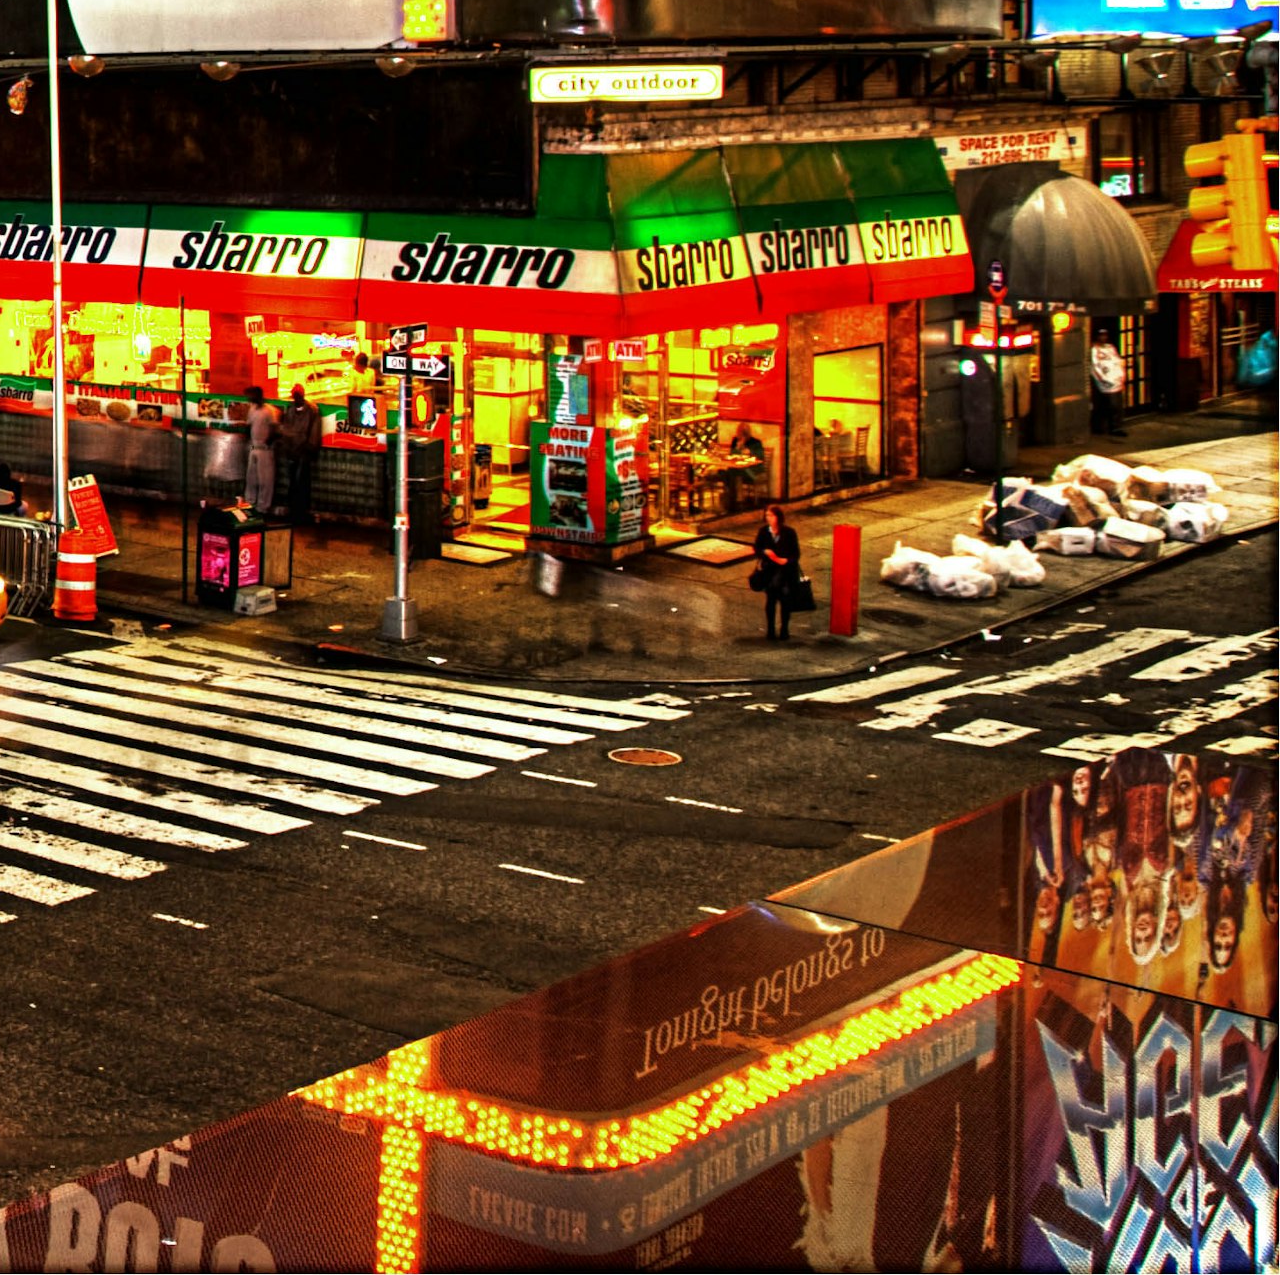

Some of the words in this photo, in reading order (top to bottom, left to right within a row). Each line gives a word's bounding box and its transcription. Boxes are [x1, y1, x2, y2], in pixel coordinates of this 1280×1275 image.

[558, 75, 598, 97] city
[610, 73, 700, 92] outdoor
[959, 136, 998, 151] SPACE
[1000, 133, 1025, 147] FOR
[1027, 131, 1057, 145] RENT
[759, 217, 850, 275] sbarro
[870, 209, 953, 261] sbarro
[173, 219, 331, 278] sbarro
[391, 232, 574, 290] sbarro
[637, 235, 734, 291] sbarro
[616, 342, 643, 358] ATM
[419, 359, 439, 371] WAY
[0, 385, 33, 402] sbarro
[548, 426, 588, 442] MORE
